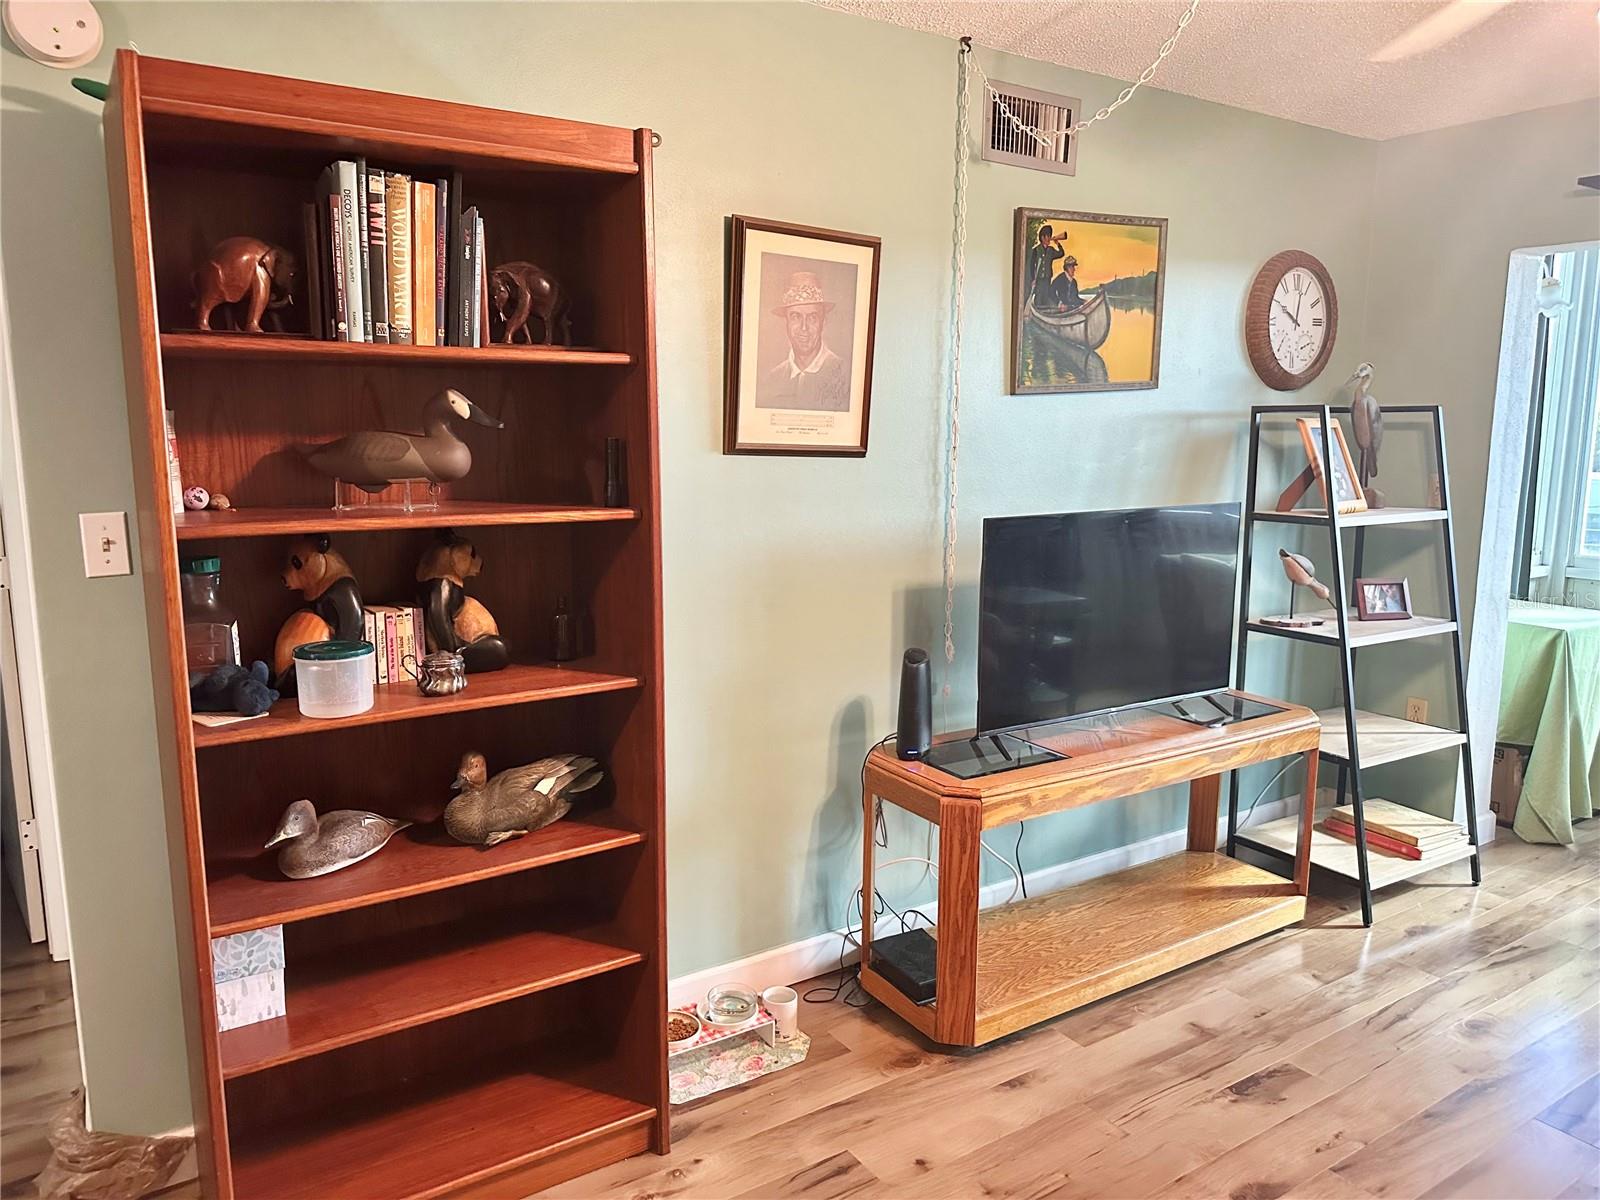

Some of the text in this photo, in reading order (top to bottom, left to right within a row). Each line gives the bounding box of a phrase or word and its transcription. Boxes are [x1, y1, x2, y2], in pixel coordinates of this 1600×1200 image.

[343, 188, 353, 219] DECOYS
[369, 202, 386, 245] WWII
[391, 208, 410, 267] WORLD
[393, 272, 409, 309] WAR
[394, 313, 410, 327] II
[1312, 318, 1322, 326] III
